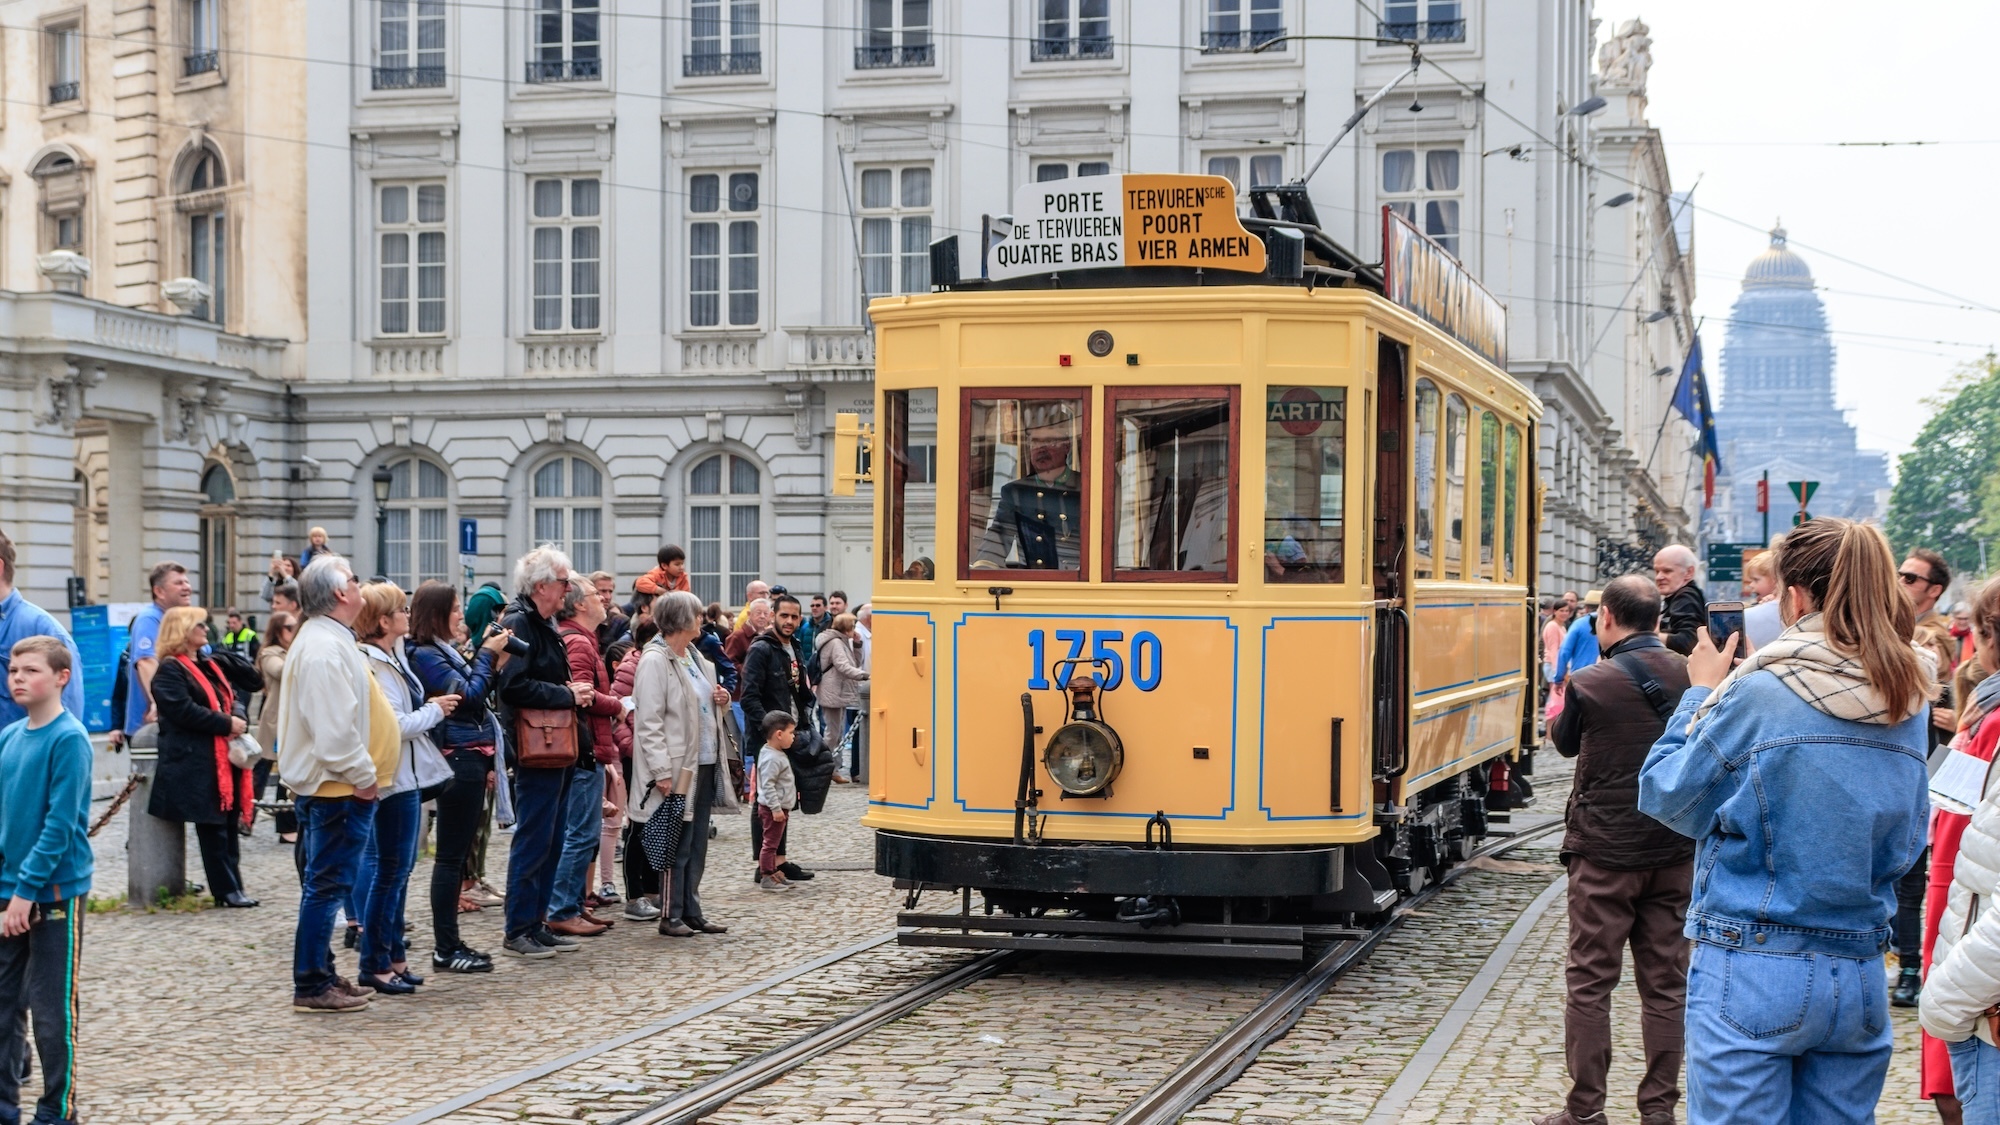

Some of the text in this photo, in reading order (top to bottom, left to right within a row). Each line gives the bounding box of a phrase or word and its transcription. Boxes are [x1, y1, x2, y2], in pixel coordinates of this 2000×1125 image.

[1044, 192, 1103, 214] PORTE
[1014, 215, 1122, 240] DE TERVUEREN
[1142, 212, 1203, 235] POORT
[997, 241, 1118, 265] QUATRE BRAS
[1137, 236, 1250, 260] VIER ARMEN
[1028, 629, 1162, 692] 1750
